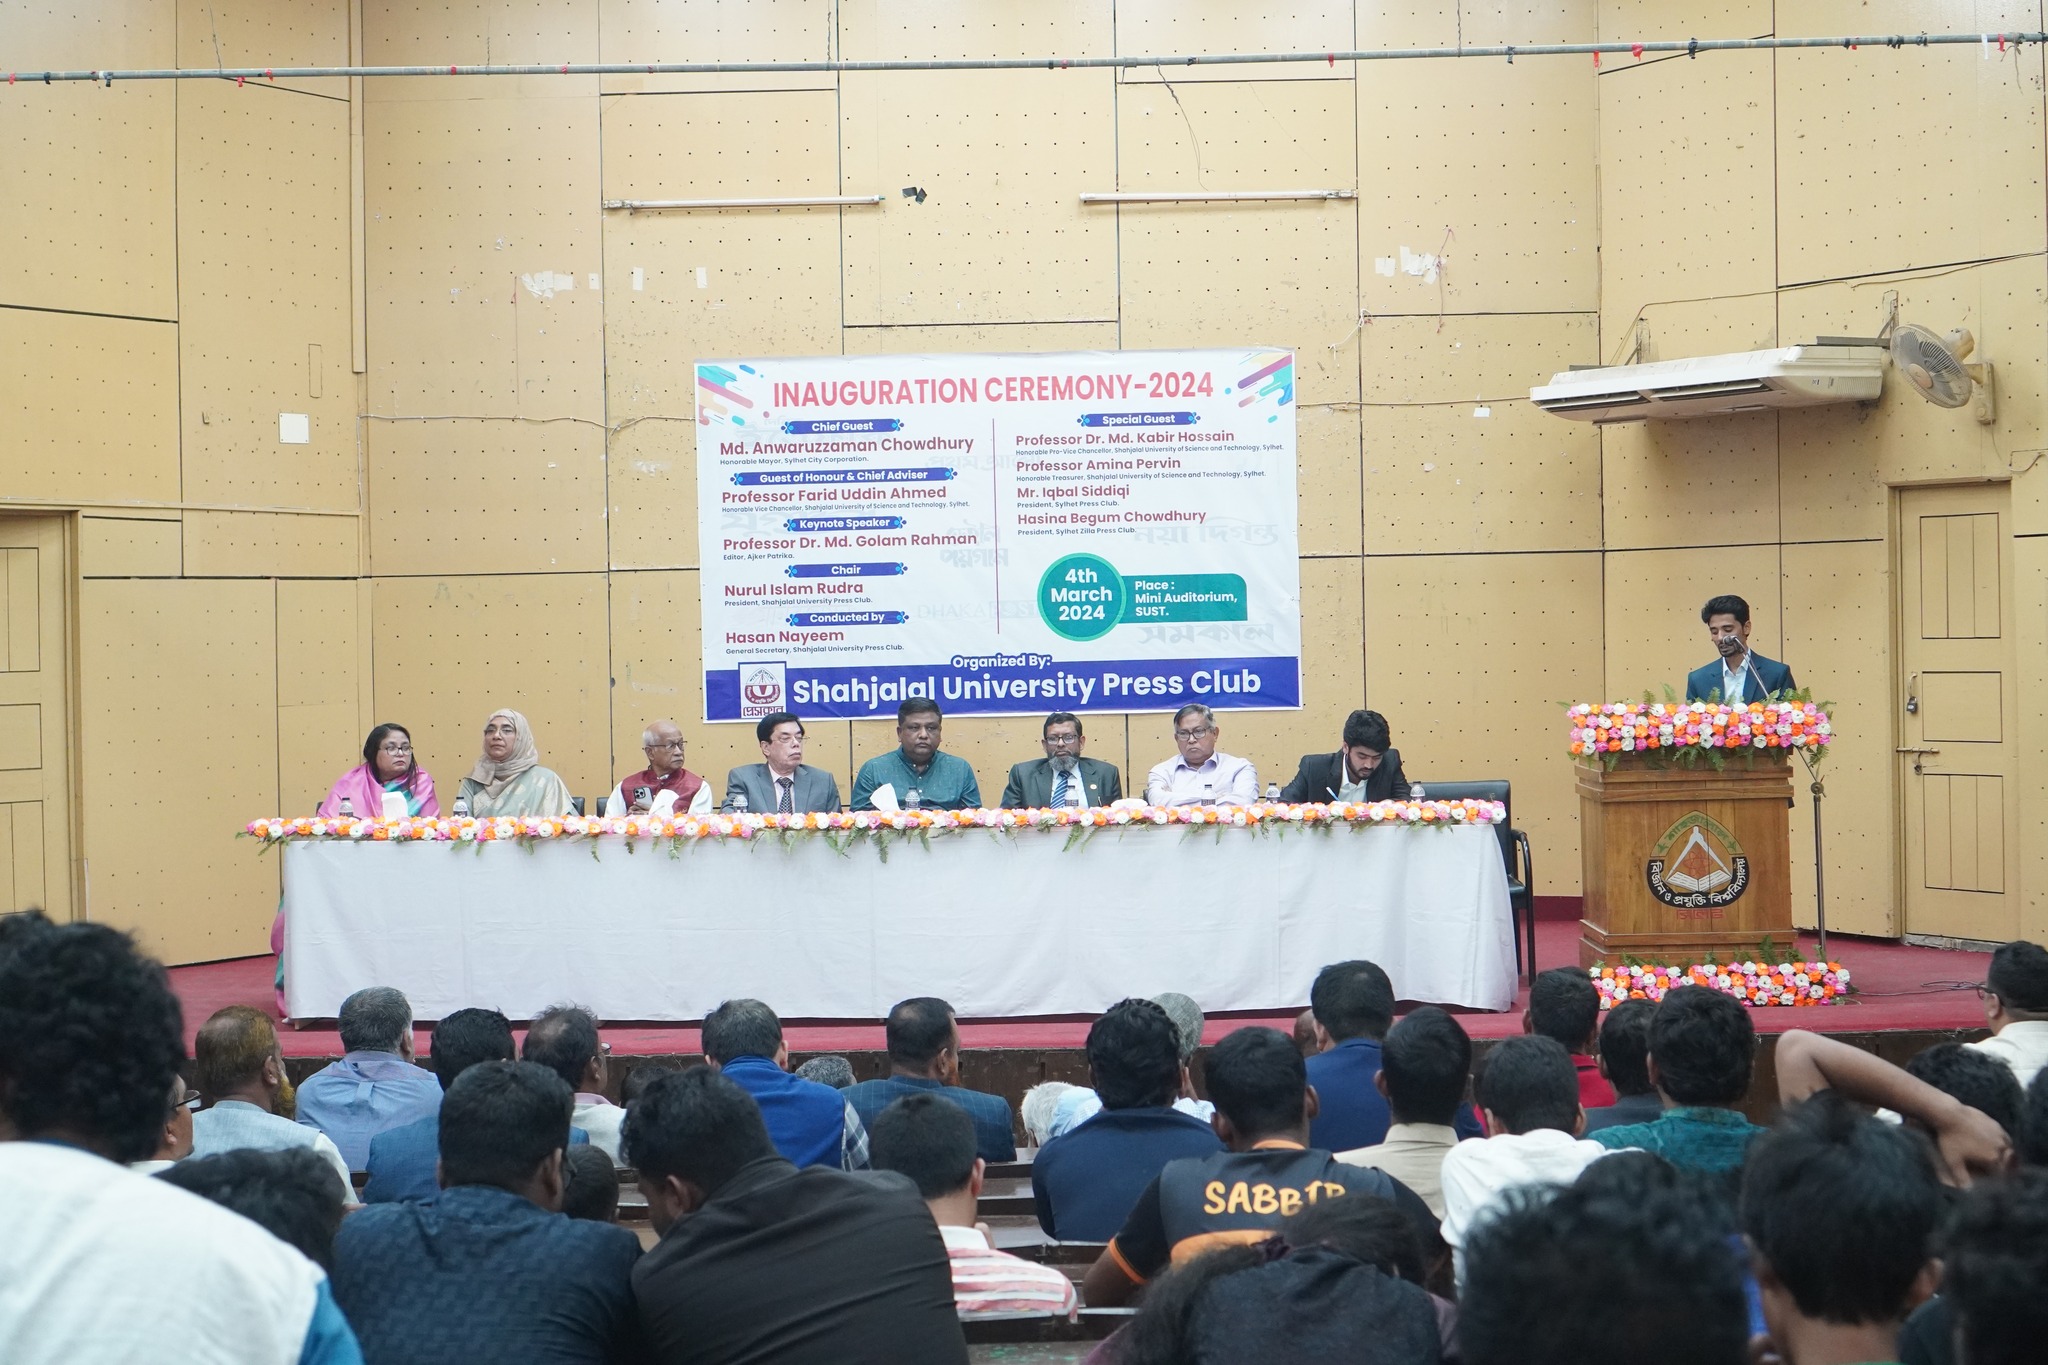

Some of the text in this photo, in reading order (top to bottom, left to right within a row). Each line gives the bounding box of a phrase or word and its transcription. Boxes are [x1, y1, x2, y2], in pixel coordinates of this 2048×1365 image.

[774, 371, 1213, 407] INAUGURATION CEREMONY-2024
[812, 422, 873, 431] Chief Guest
[1102, 414, 1176, 428] Special Guest
[1016, 430, 1234, 446] Professor Dr. Md. Kabir Hossain
[720, 436, 974, 455] Md. Anwaruzzaman Chowdhury
[1114, 447, 1144, 455] Shahjalal
[824, 456, 869, 464] Corporation.
[1017, 457, 1181, 472] Professor Amina Pervin
[760, 470, 928, 483] Guest of Honour & Chief Adviser
[1202, 471, 1242, 479] Technology,
[722, 486, 946, 503] Professor Farid Uddin Ahmed
[1017, 484, 1129, 500] Mr. Iqbal Siddiqi
[804, 504, 833, 512] Shahjalal
[834, 503, 864, 512] University
[911, 502, 948, 510] Technology,
[1055, 501, 1078, 509] Sylhet
[800, 519, 844, 531] Keynote
[846, 518, 890, 530] Speaker
[1018, 510, 1206, 526] Hasina Begum Chowdhury
[1056, 528, 1079, 536] Sylhet
[724, 533, 977, 550] Professor Dr. Md. Golam Rahman
[747, 553, 766, 561] Ajker
[831, 565, 861, 574] Chair
[1065, 568, 1097, 583] 4th
[725, 582, 863, 596] Nurul Islam Rudra
[1135, 580, 1169, 590] Place
[1051, 586, 1112, 602] March
[1135, 591, 1237, 603] Mini Auditorium,
[796, 598, 832, 606] University
[809, 611, 885, 624] Conducted by
[1059, 605, 1105, 620] 2024
[1135, 606, 1169, 616] SUST.
[726, 631, 844, 646] Hasan Nayeem
[793, 646, 827, 654] Shahjalal
[828, 645, 864, 653] University
[953, 654, 1051, 672] Organized By:
[793, 676, 935, 709] Shahjalal
[943, 671, 1096, 704] University
[1103, 673, 1183, 696] Press
[1191, 669, 1261, 693] Club
[1673, 893, 1707, 907] প্রযুক্তি
